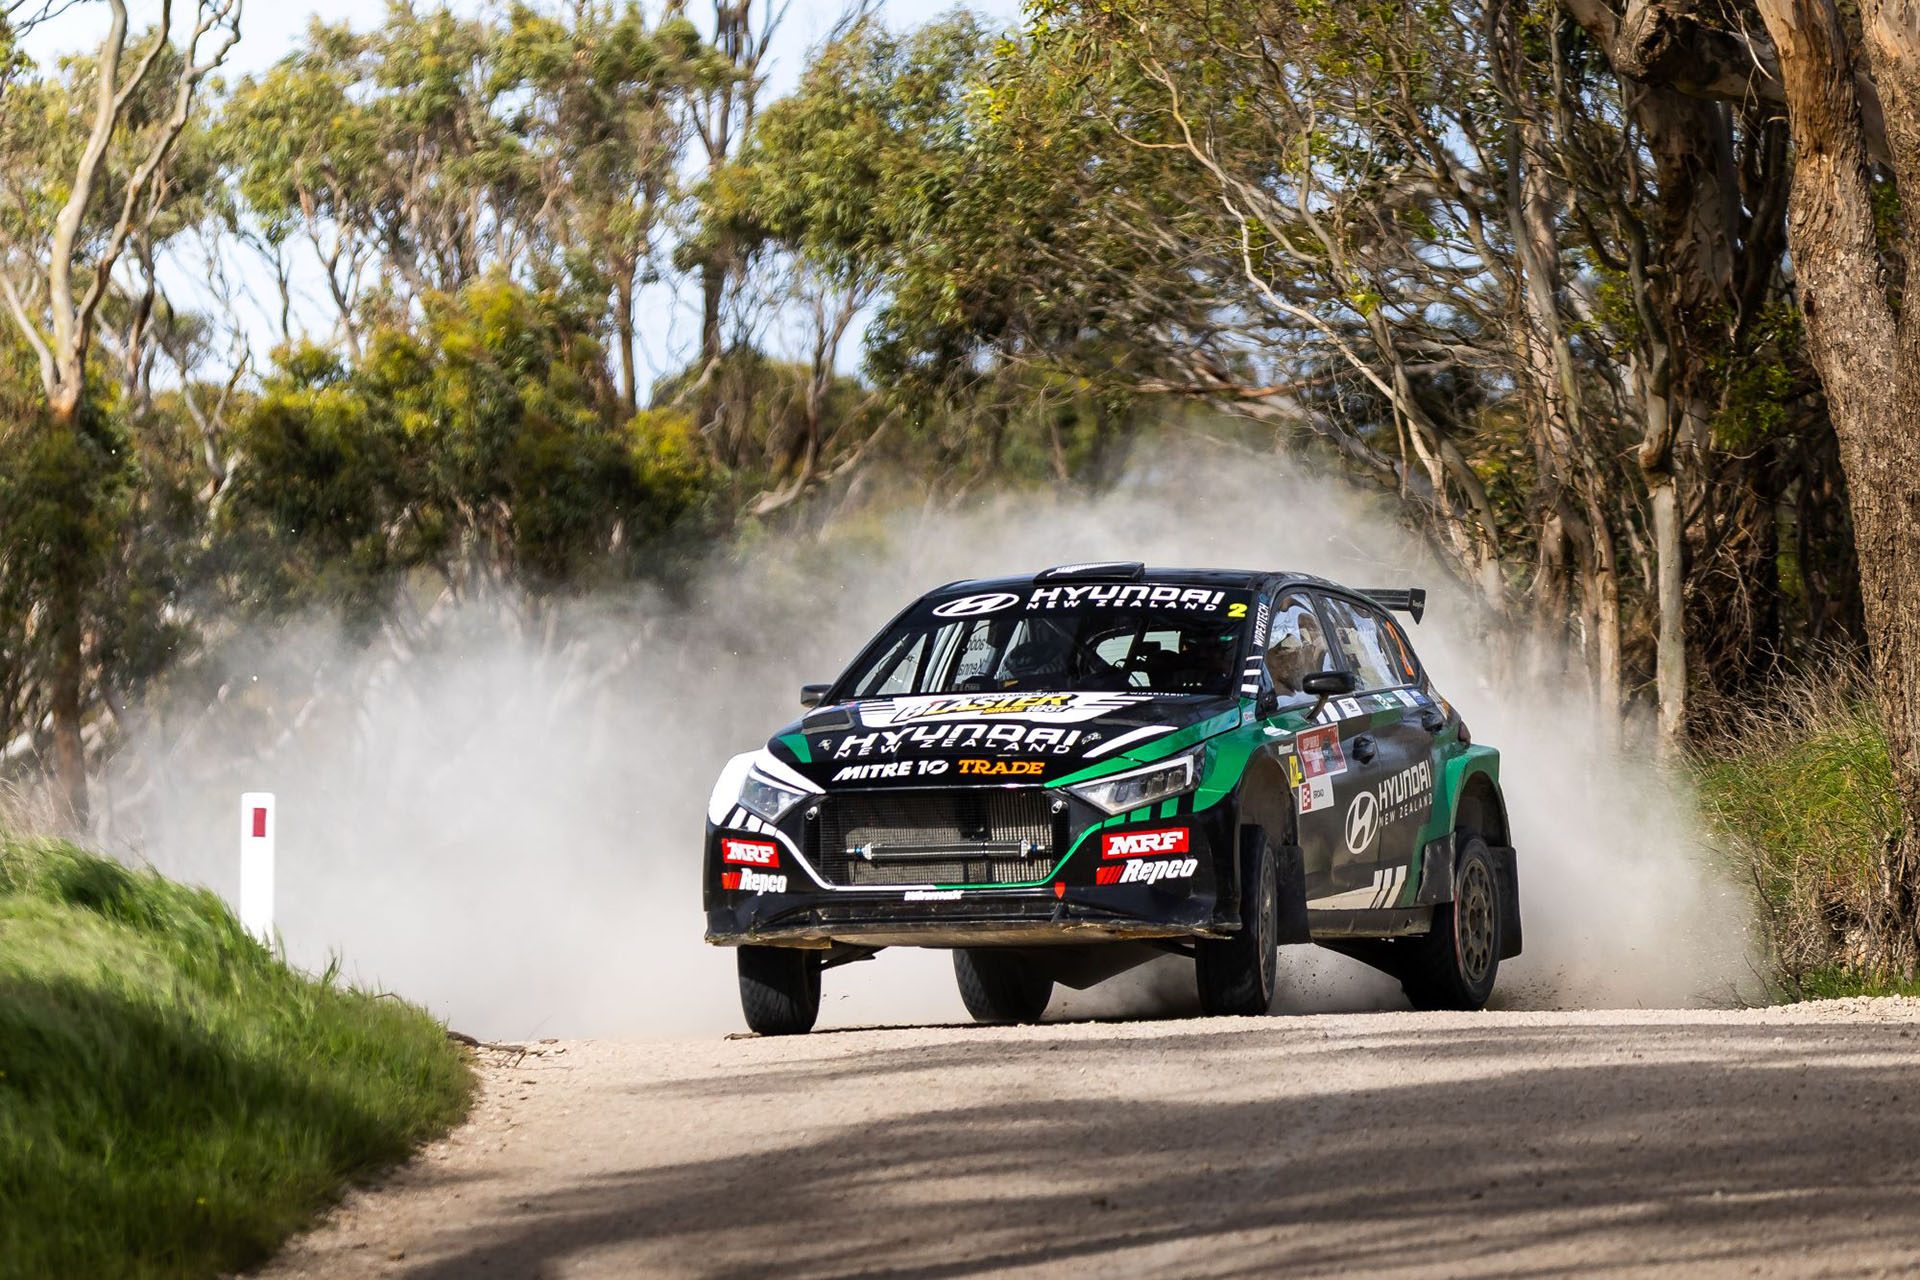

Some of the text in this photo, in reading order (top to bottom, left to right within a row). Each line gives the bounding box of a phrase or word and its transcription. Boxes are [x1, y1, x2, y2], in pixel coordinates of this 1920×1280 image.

[1026, 600, 1217, 611] NEW ZEALAND
[1030, 586, 1225, 605] HYUNDAI
[1227, 603, 1248, 618] 2
[1253, 602, 1270, 647] WIPERTECH
[981, 705, 1026, 715] SINCE
[840, 724, 1082, 748] HYUNDAI
[833, 741, 907, 759] NEW
[919, 739, 1071, 754] ZEALAND
[832, 759, 1046, 782] MITRE 10 TRADE
[1378, 759, 1432, 812] HYUNDAI
[1379, 792, 1433, 828] NEW ZEALAND
[727, 842, 774, 863] MRF
[1107, 831, 1184, 856] MRF
[739, 868, 788, 896] Repco
[1118, 858, 1198, 885] Repco
